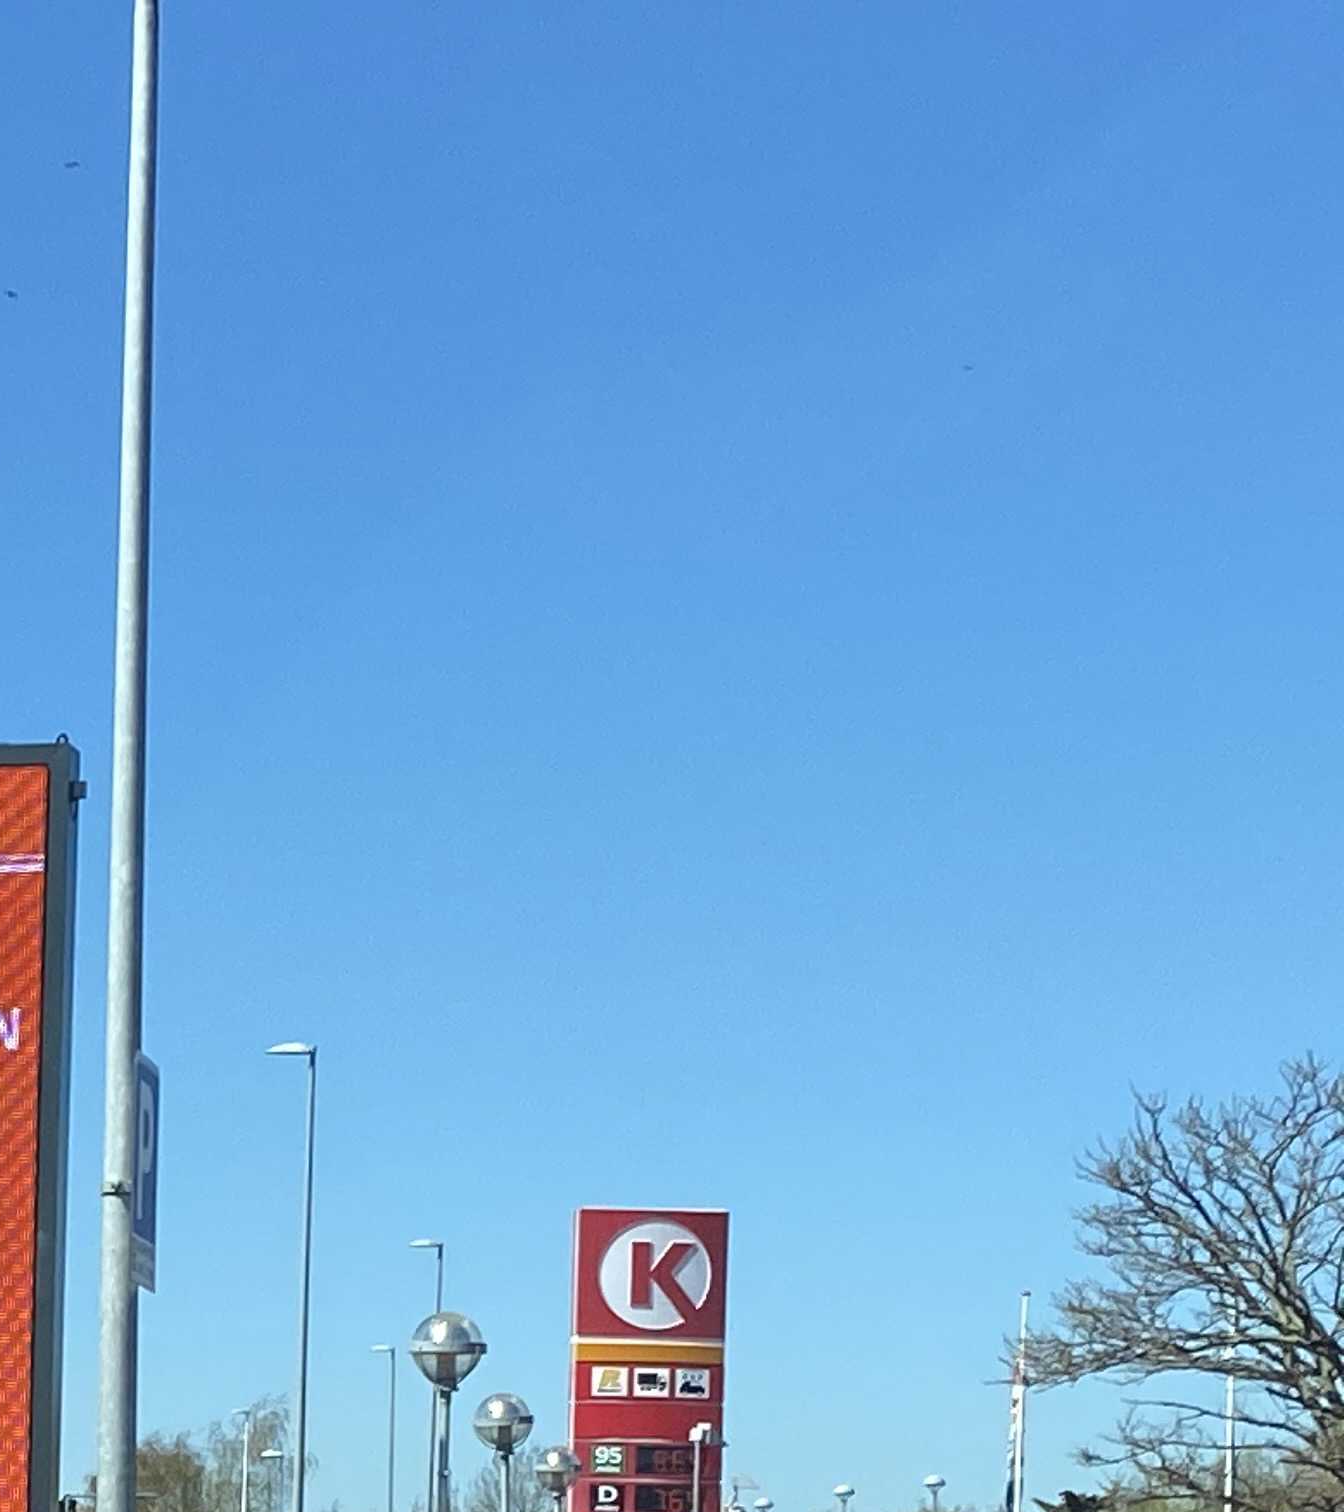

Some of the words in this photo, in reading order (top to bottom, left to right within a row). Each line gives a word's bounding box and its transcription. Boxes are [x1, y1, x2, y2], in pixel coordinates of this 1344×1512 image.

[629, 1240, 699, 1322] K
[594, 1446, 623, 1465] 95
[598, 1485, 619, 1503] D
